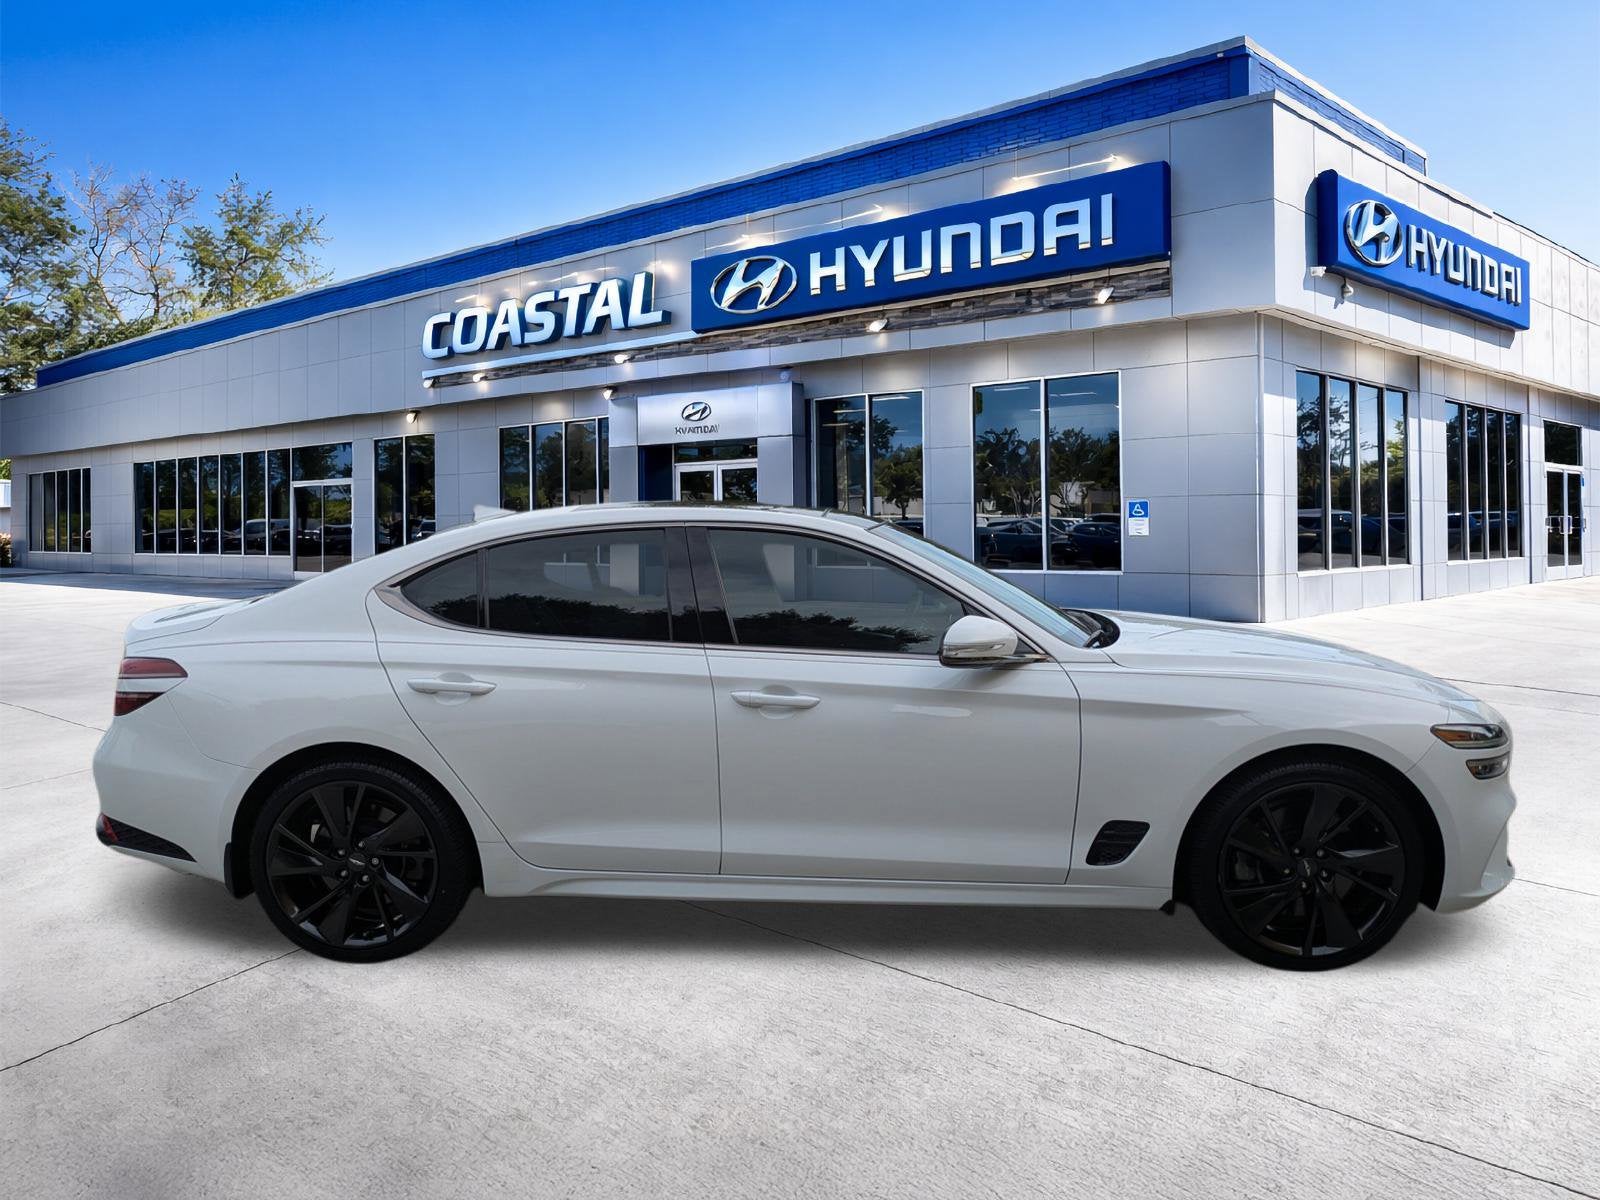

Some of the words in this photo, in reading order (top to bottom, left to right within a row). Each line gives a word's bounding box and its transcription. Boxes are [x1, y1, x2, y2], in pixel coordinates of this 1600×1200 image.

[809, 193, 1114, 296] HYUNDAI
[1407, 224, 1521, 305] HYUNDAI
[422, 271, 670, 360] COASTAL
